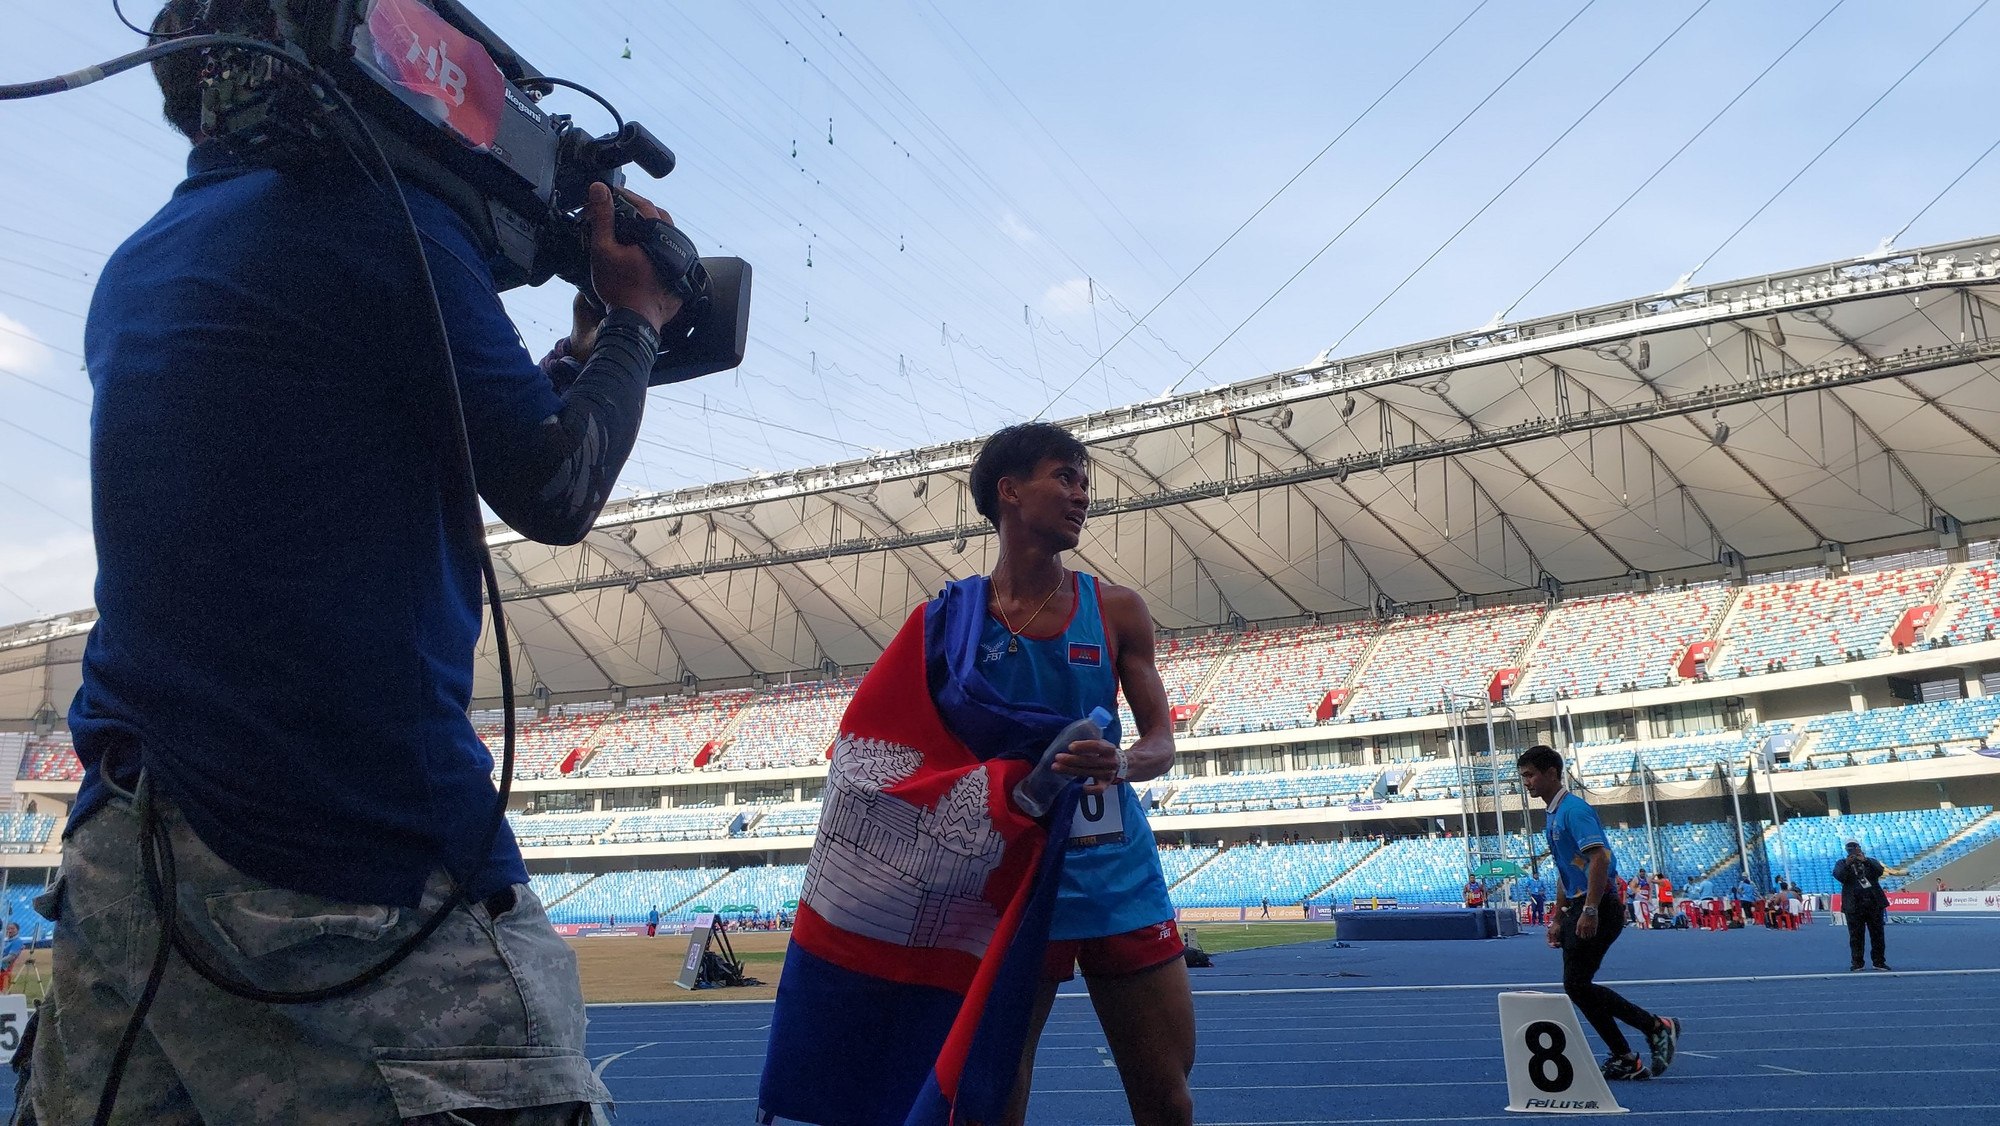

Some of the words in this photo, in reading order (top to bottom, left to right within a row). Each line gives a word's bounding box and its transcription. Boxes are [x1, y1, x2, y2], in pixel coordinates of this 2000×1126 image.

[505, 88, 542, 123] Ikegami
[660, 233, 687, 258] Canon
[983, 652, 1005, 662] FBT
[1159, 928, 1171, 940] FBT
[0, 1013, 20, 1051] 5
[1525, 1021, 1574, 1092] 8
